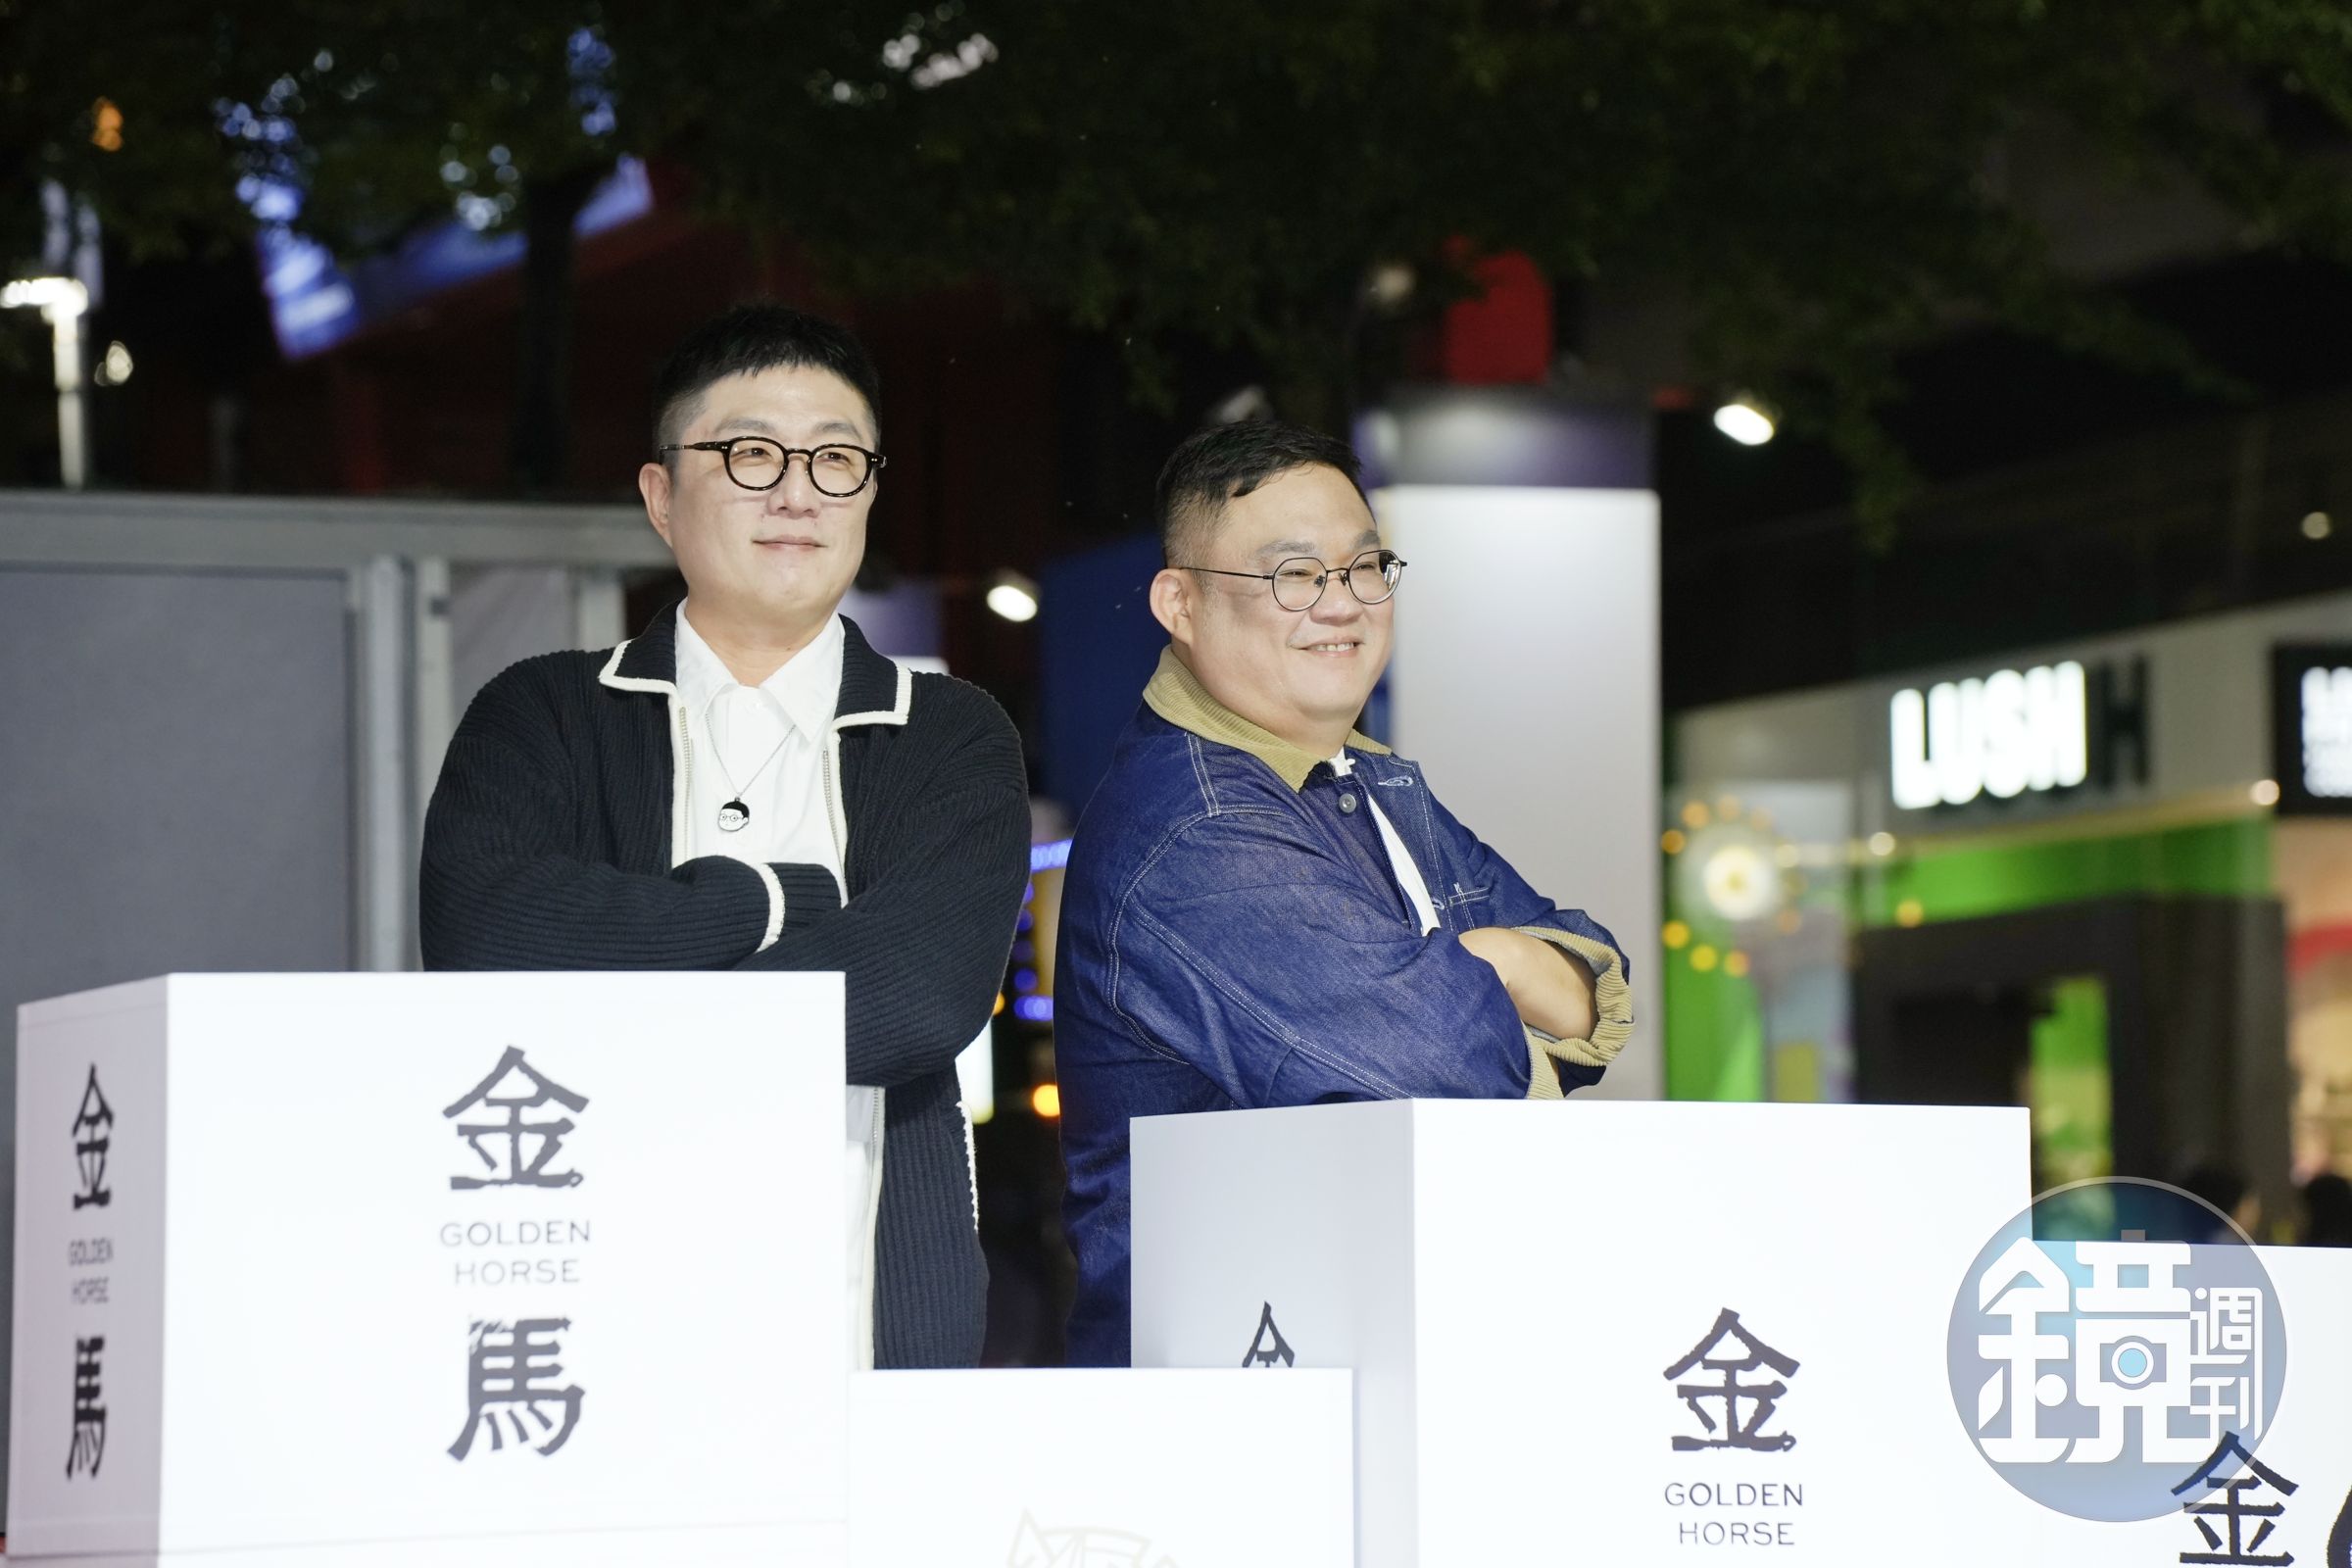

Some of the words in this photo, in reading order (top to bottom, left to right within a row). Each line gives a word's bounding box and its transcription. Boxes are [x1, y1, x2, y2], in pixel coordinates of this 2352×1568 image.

[1890, 661, 2086, 808] LUSH
[71, 1063, 115, 1210] 金
[442, 1045, 590, 1191] 金
[440, 1219, 591, 1248] GOLDEN
[454, 1259, 580, 1286] HORSE
[65, 1335, 107, 1480] 馬
[446, 1314, 586, 1462] 馬
[1663, 1307, 1801, 1452] 金
[1664, 1481, 1804, 1508] GOLDEN
[1678, 1520, 1796, 1547] HORSE
[2171, 1430, 2299, 1568] 金
